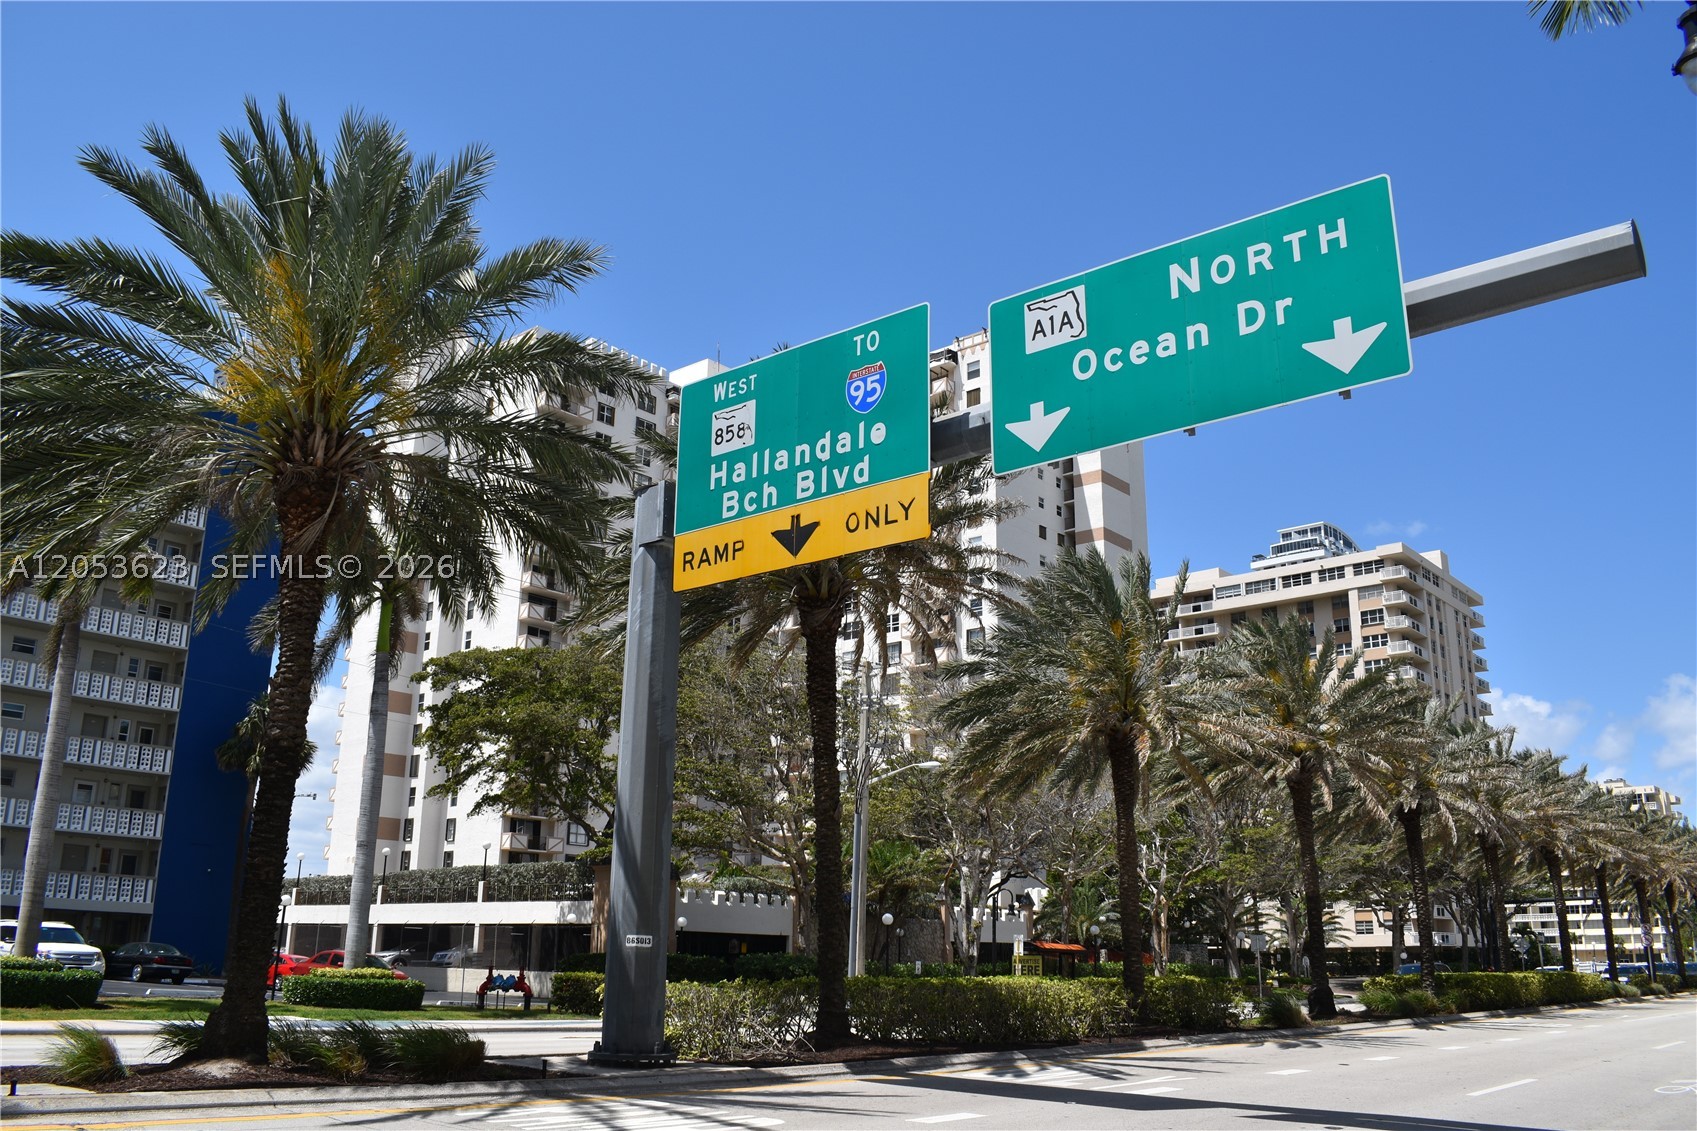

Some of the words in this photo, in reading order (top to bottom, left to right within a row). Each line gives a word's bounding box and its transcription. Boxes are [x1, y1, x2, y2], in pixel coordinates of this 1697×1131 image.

[1169, 217, 1348, 300] NORTH
[853, 330, 880, 356] TO
[1031, 310, 1075, 343] A1A
[1072, 321, 1209, 381] Ocean
[1236, 296, 1293, 336] Dr
[852, 364, 881, 379] INTERSTATE
[713, 374, 758, 403] WEST
[849, 373, 882, 406] 95
[714, 422, 746, 446] 858
[722, 482, 778, 519] Bch
[796, 454, 870, 500] Blvd
[682, 540, 745, 573] RAMP
[845, 497, 916, 534] ONLY
